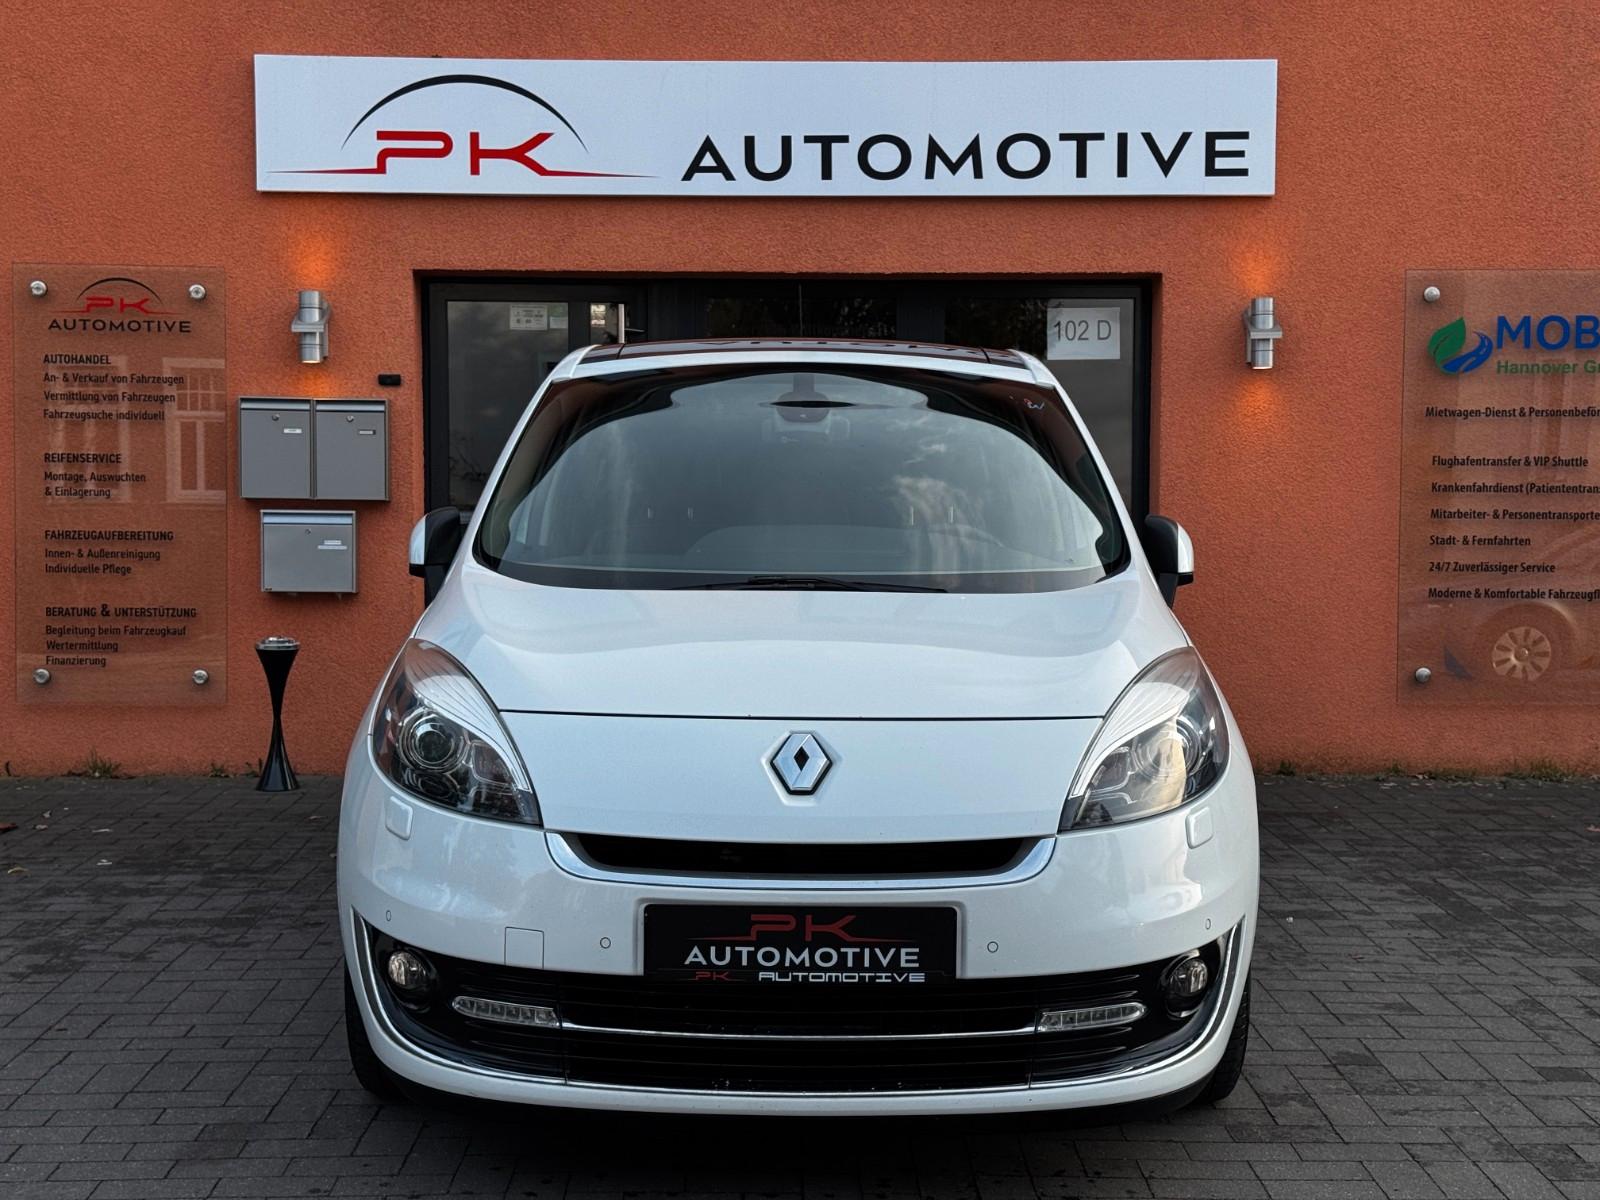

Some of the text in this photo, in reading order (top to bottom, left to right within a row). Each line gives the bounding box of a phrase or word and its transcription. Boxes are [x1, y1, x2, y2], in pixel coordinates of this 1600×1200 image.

[376, 128, 1250, 183] PK AUTOMOTIVE
[85, 297, 150, 314] PK
[48, 318, 192, 334] AUTOMOTIVE
[1053, 320, 1111, 341] 102 D
[1496, 315, 1600, 350] MOB
[43, 354, 112, 366] AUTOHANDEL
[1497, 361, 1578, 374] Hannover
[43, 372, 184, 386] An- & Verkauf von Fahrzeugen
[44, 391, 176, 404] Vermittlung von Fahrzeugen
[43, 409, 165, 422] Fahrzeugsuche individuell
[1425, 407, 1516, 420] Mietwagen-Dienst
[1519, 408, 1526, 417] &
[44, 453, 122, 464] REIFENSERVICE
[1432, 456, 1589, 468] Flughafentransfer & VIP Shuttle
[44, 471, 146, 483] Montage, Auswuchten
[44, 487, 111, 499] & Einlagerung
[1431, 483, 1523, 493] Krankenfahrdienst
[1430, 509, 1490, 519] Mitarbeiter-
[1493, 510, 1500, 519] &
[44, 530, 174, 541] FAHRZEUGAUFBEREITUNG
[1430, 535, 1531, 546] Stadt- & Fernfahrten
[45, 549, 161, 561] Innen- & Außenreinigung
[45, 564, 132, 576] Individuelle Pflege
[1429, 562, 1555, 575] 24/7 Zuverlässiger Service
[1428, 588, 1472, 599] Moderne
[1474, 589, 1481, 598] &
[1484, 588, 1545, 599] Komfortable
[45, 604, 198, 618] BERATUNG & UNTERSTÜTZUNG
[46, 625, 187, 637] Begleitung beim Fahrzeugkauf
[46, 640, 119, 652] Wertermittlung
[46, 655, 107, 667] Finanzierung
[751, 914, 857, 941] PK
[684, 946, 920, 967] AUTOMOTIVE
[695, 971, 925, 983] PK AUTOMOTIVE
